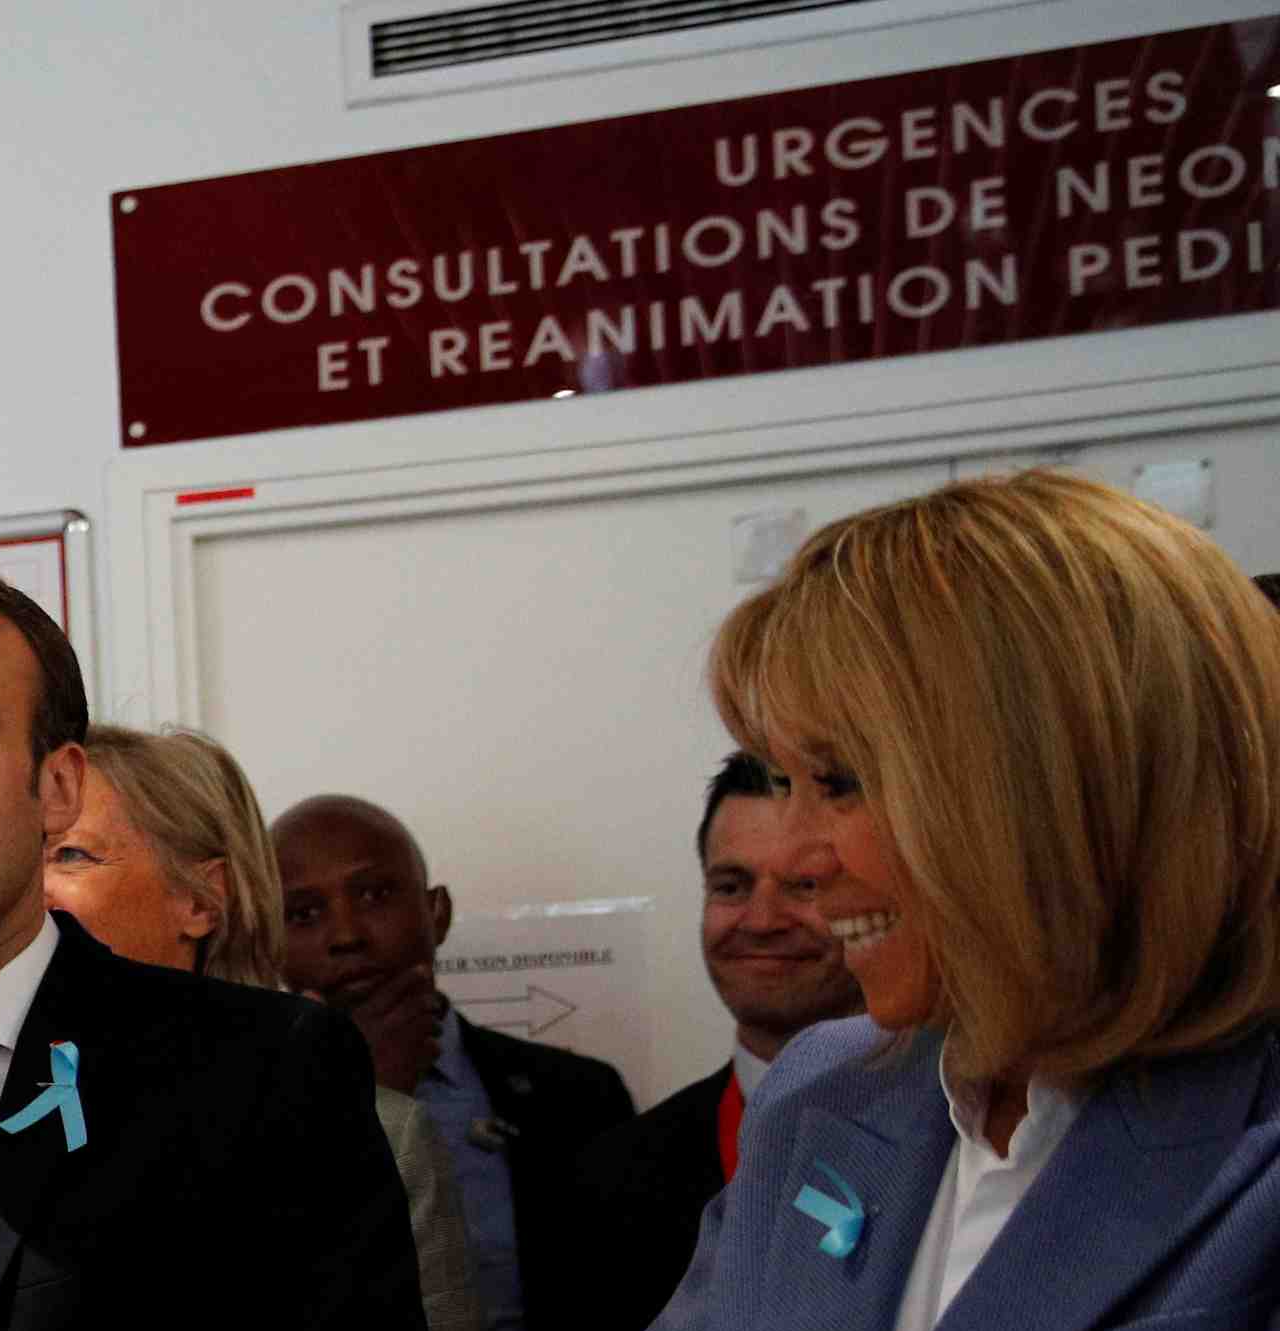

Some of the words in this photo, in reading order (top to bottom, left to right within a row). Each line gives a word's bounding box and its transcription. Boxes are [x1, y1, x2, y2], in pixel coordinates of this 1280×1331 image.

[715, 71, 1186, 187] URGENCES
[200, 198, 860, 331] CONSULTATIONS
[905, 177, 1006, 239] DE
[318, 336, 390, 392] ET
[429, 254, 1017, 378] REANIMATION
[1069, 221, 1280, 296] PEDI
